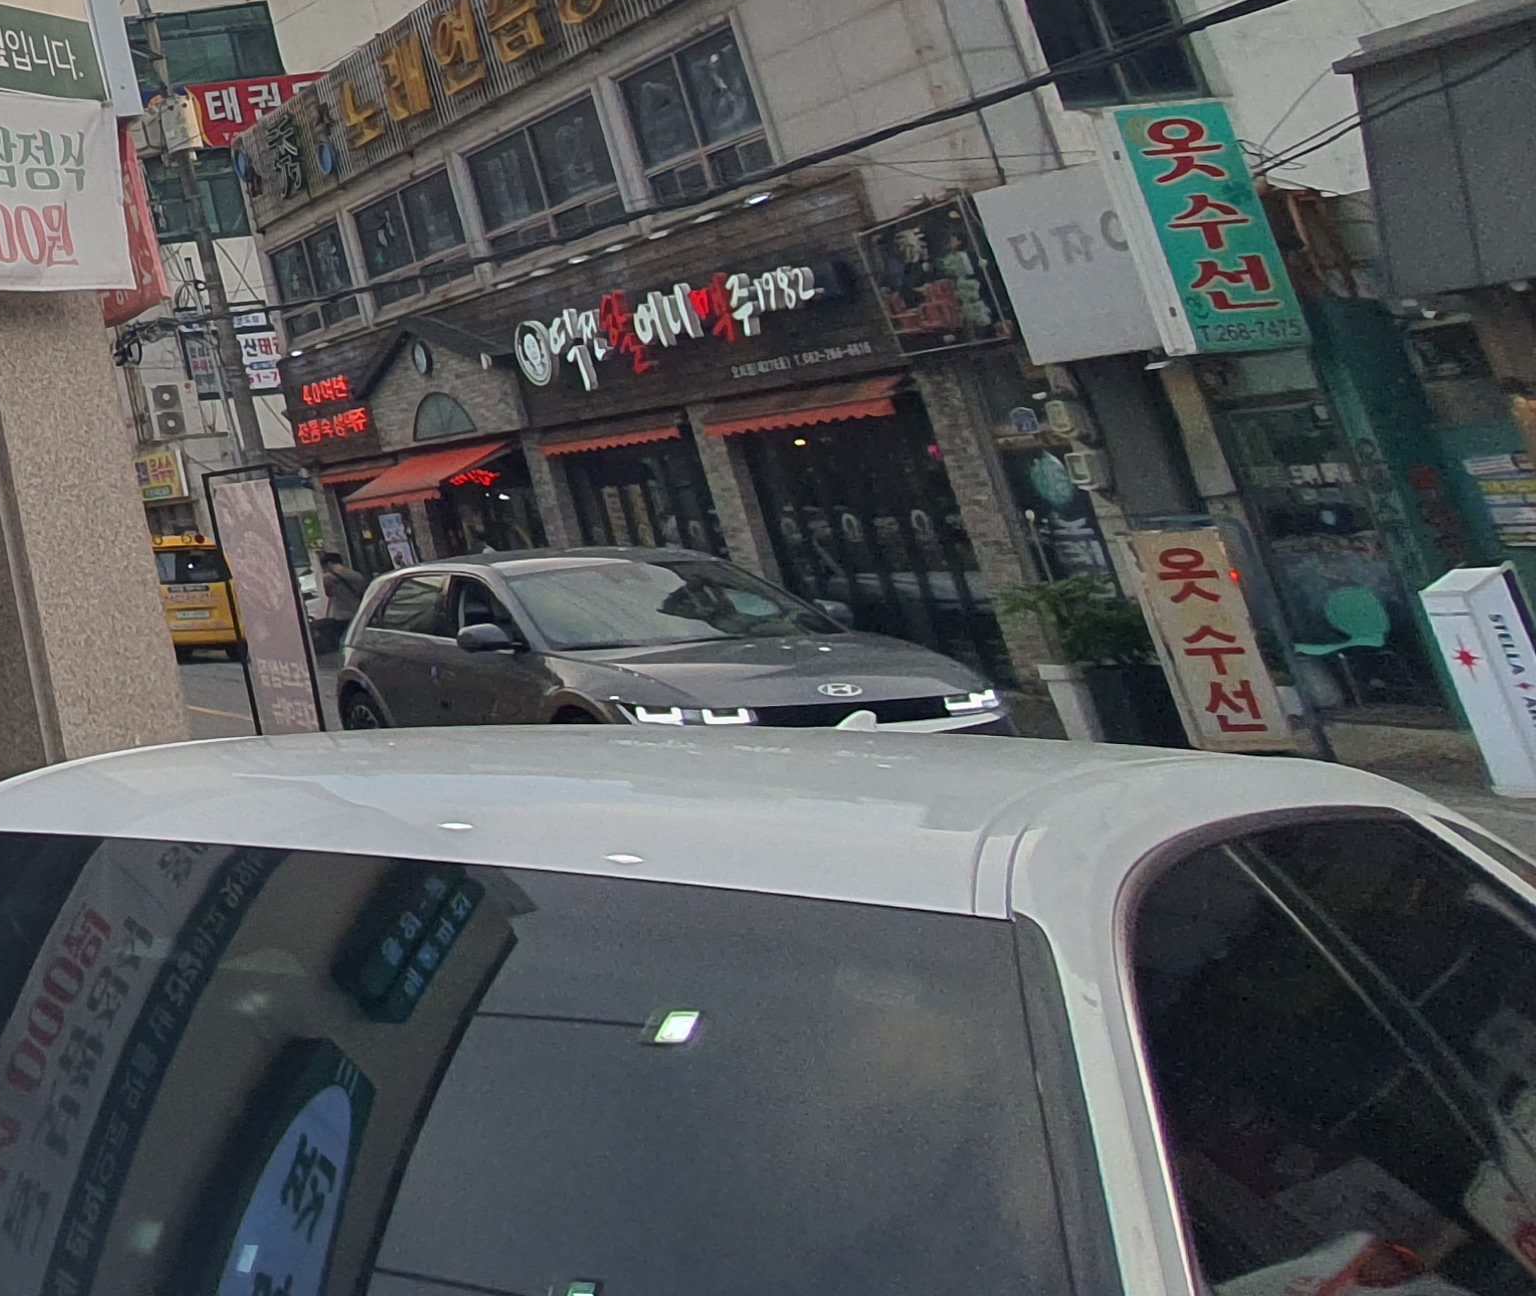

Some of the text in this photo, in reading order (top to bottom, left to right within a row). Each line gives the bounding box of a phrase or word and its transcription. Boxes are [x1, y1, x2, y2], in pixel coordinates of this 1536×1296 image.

[1141, 116, 1281, 311] 옷수선
[1156, 546, 1271, 737] 옷수선
[1488, 614, 1526, 675] STELLA
